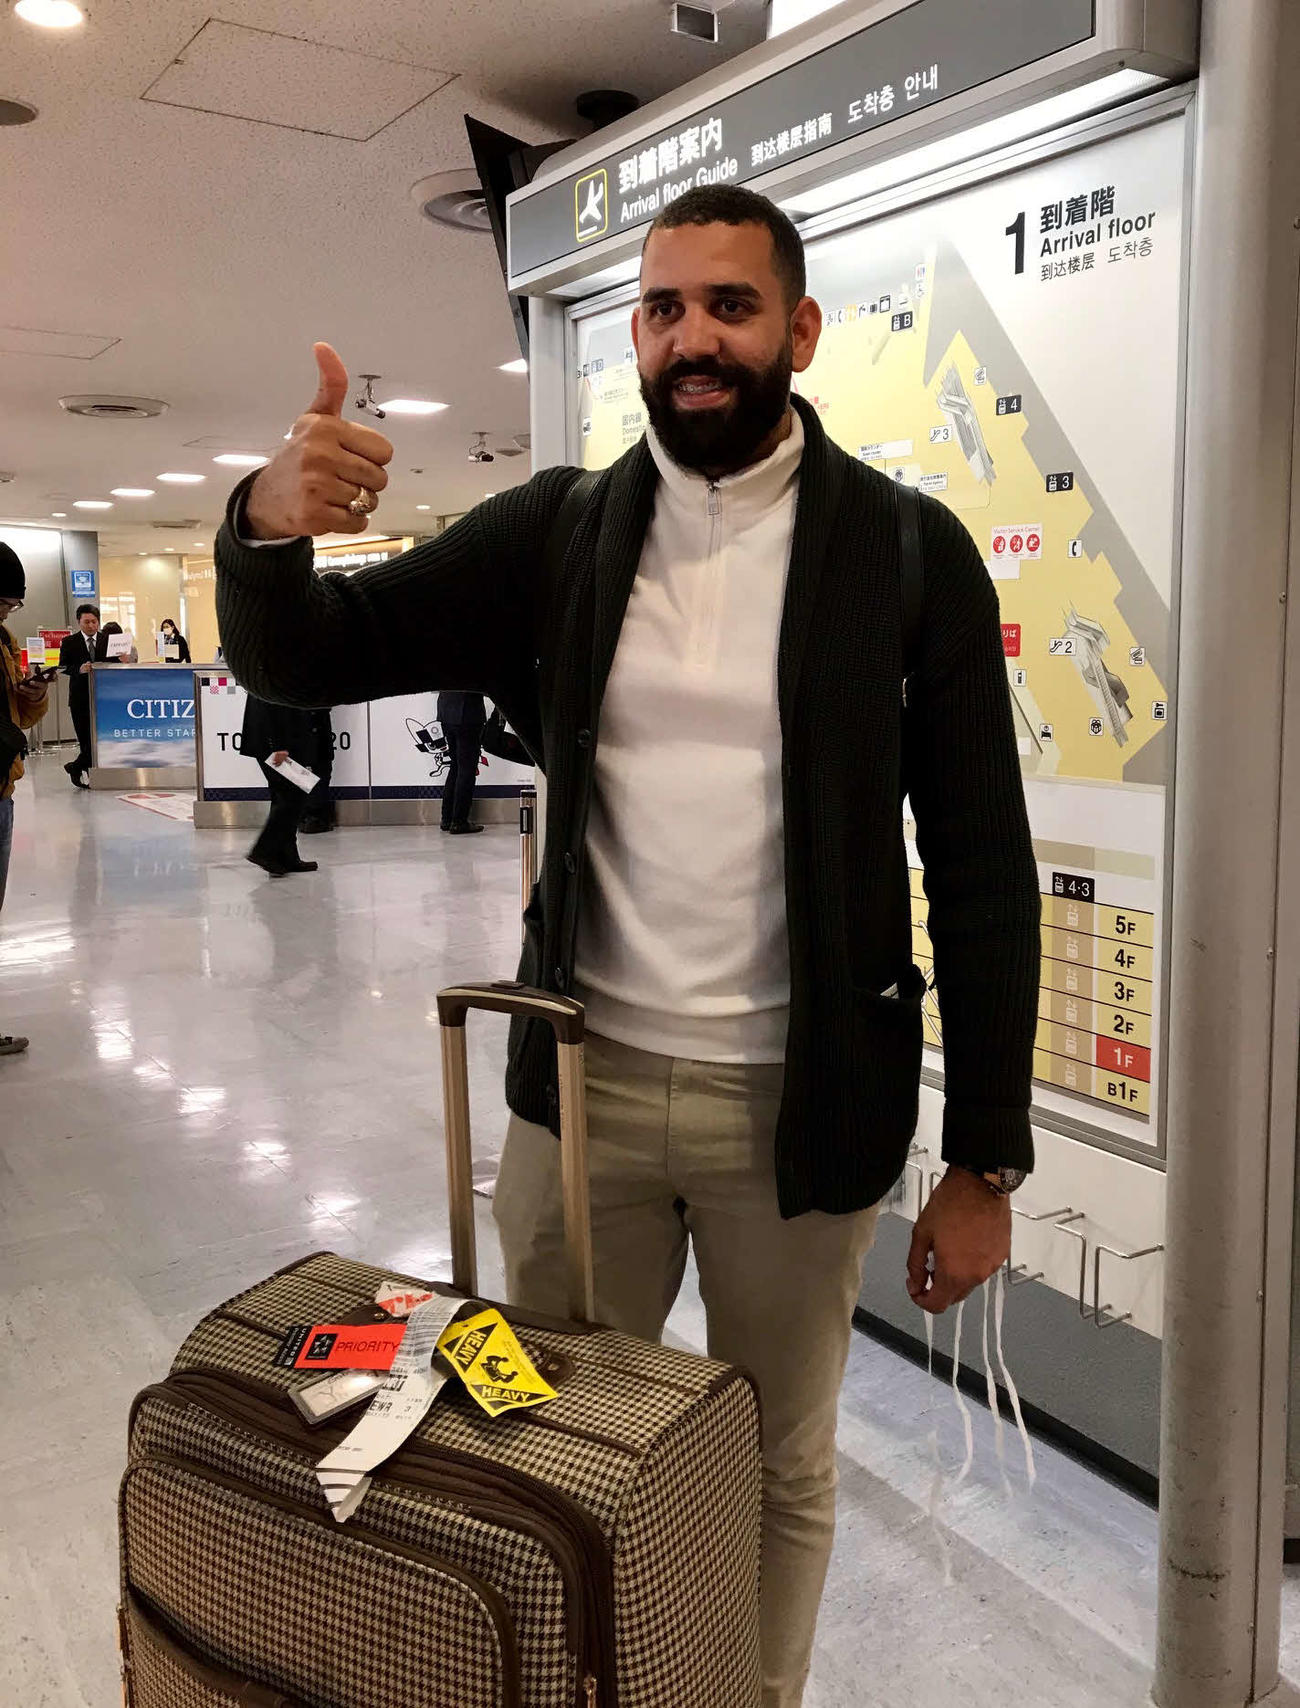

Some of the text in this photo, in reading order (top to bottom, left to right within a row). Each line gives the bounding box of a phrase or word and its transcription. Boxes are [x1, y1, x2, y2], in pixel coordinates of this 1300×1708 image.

[848, 64, 938, 124] 도착층 안내
[751, 112, 833, 167] 到达楼层指南
[618, 117, 723, 194] 到着階案内
[620, 156, 739, 223] Arrival floor Guide
[1039, 185, 1116, 234] 到着階
[1005, 211, 1026, 275] 1
[1039, 212, 1156, 258] Arrival floor
[1107, 237, 1154, 264] 도착층
[1041, 252, 1095, 282] 到达楼层
[903, 314, 911, 327] B
[1010, 398, 1018, 411] 4
[942, 428, 949, 441] 3
[1062, 475, 1070, 489] 3
[1064, 640, 1073, 654] 2
[127, 698, 196, 719] CITIZ
[113, 728, 161, 738] BETTER
[1115, 914, 1136, 936] 5F
[1114, 948, 1136, 969] 4F
[1114, 981, 1135, 1002] 3F
[1113, 1014, 1135, 1035] 2F
[1113, 1047, 1134, 1068] 1F
[1107, 1081, 1138, 1102] B1F
[336, 1340, 401, 1352] PRIORITY
[455, 1330, 488, 1365] HEAVY
[481, 1385, 531, 1402] HEAVY
